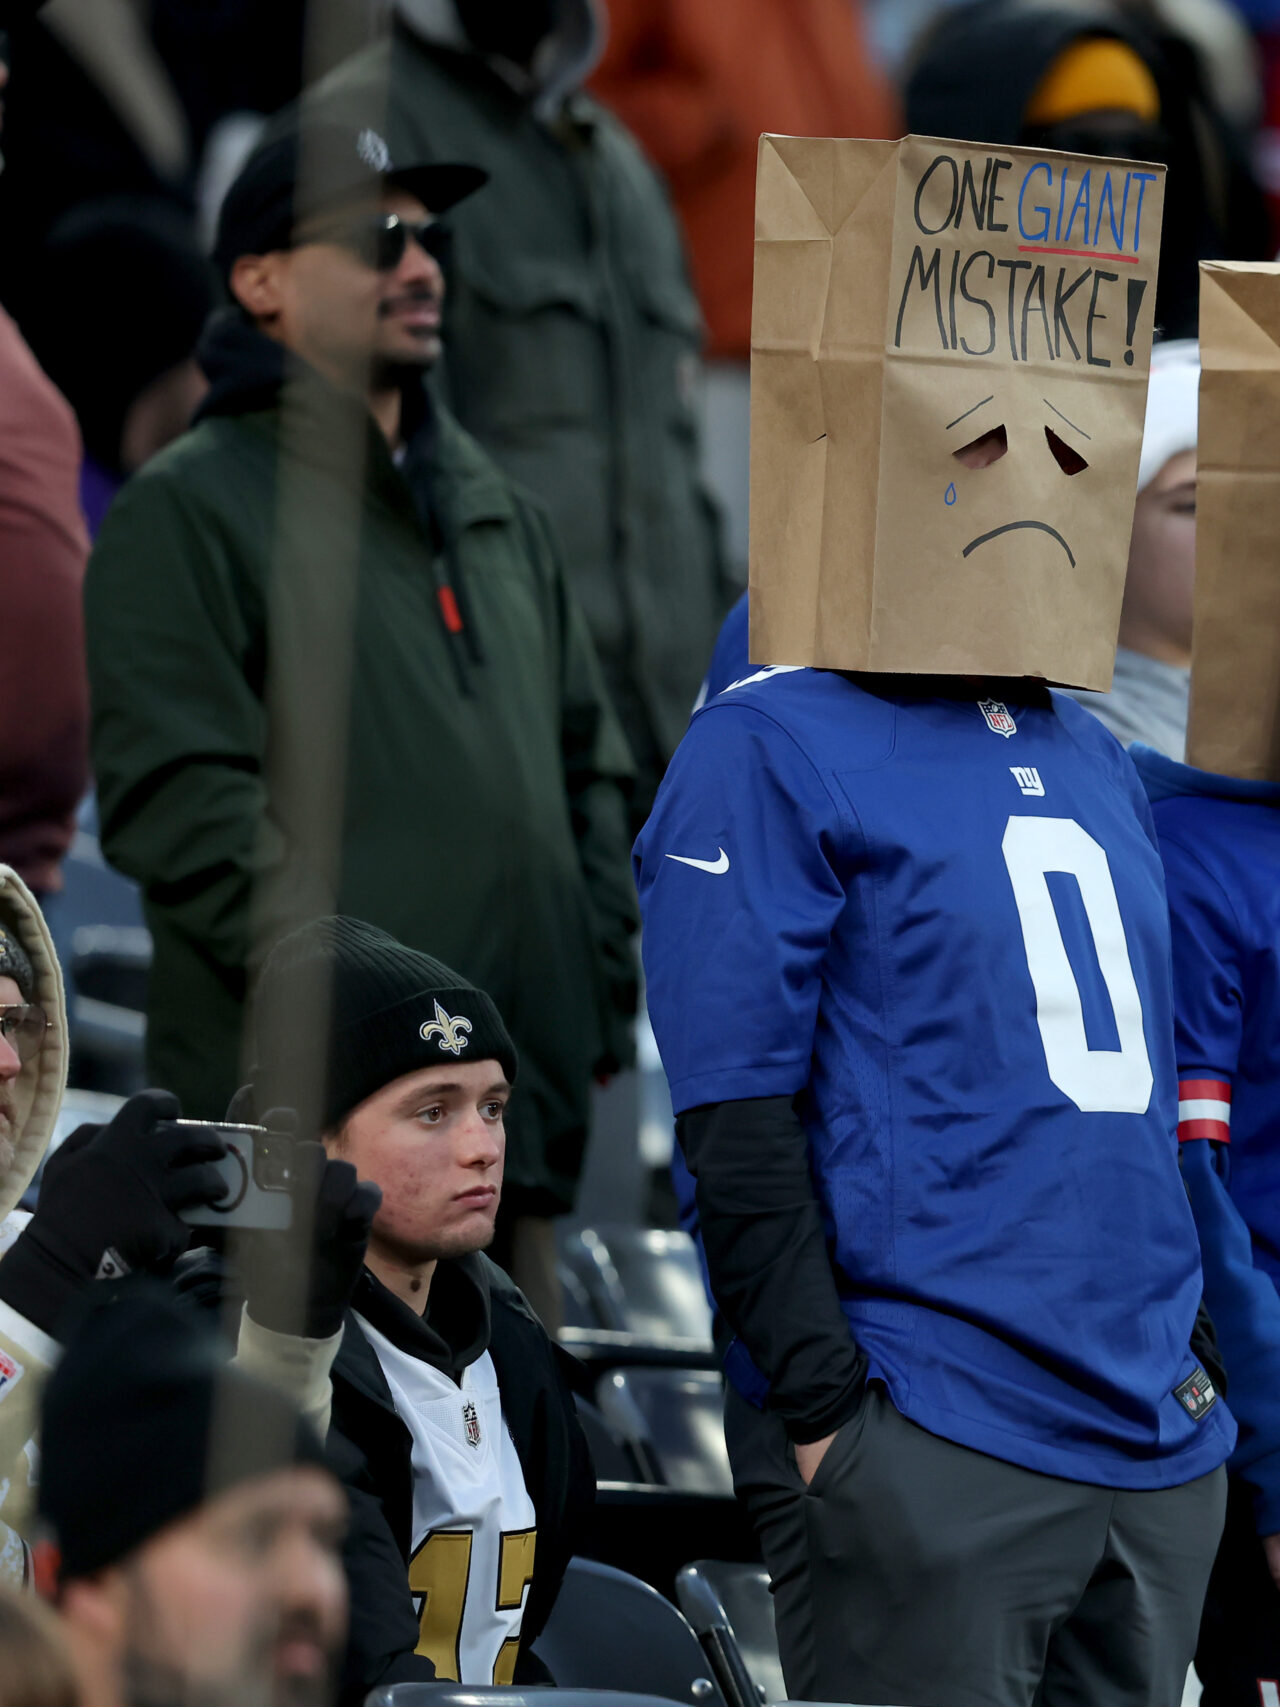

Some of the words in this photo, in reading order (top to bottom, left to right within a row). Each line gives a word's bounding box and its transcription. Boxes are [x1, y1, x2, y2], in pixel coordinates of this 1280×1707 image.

[914, 155, 1013, 235] ONE
[1017, 162, 1157, 252] GIANT
[894, 245, 1148, 368] MISTAKE!
[989, 713, 1013, 730] NFL
[1001, 815, 1155, 1115] 0
